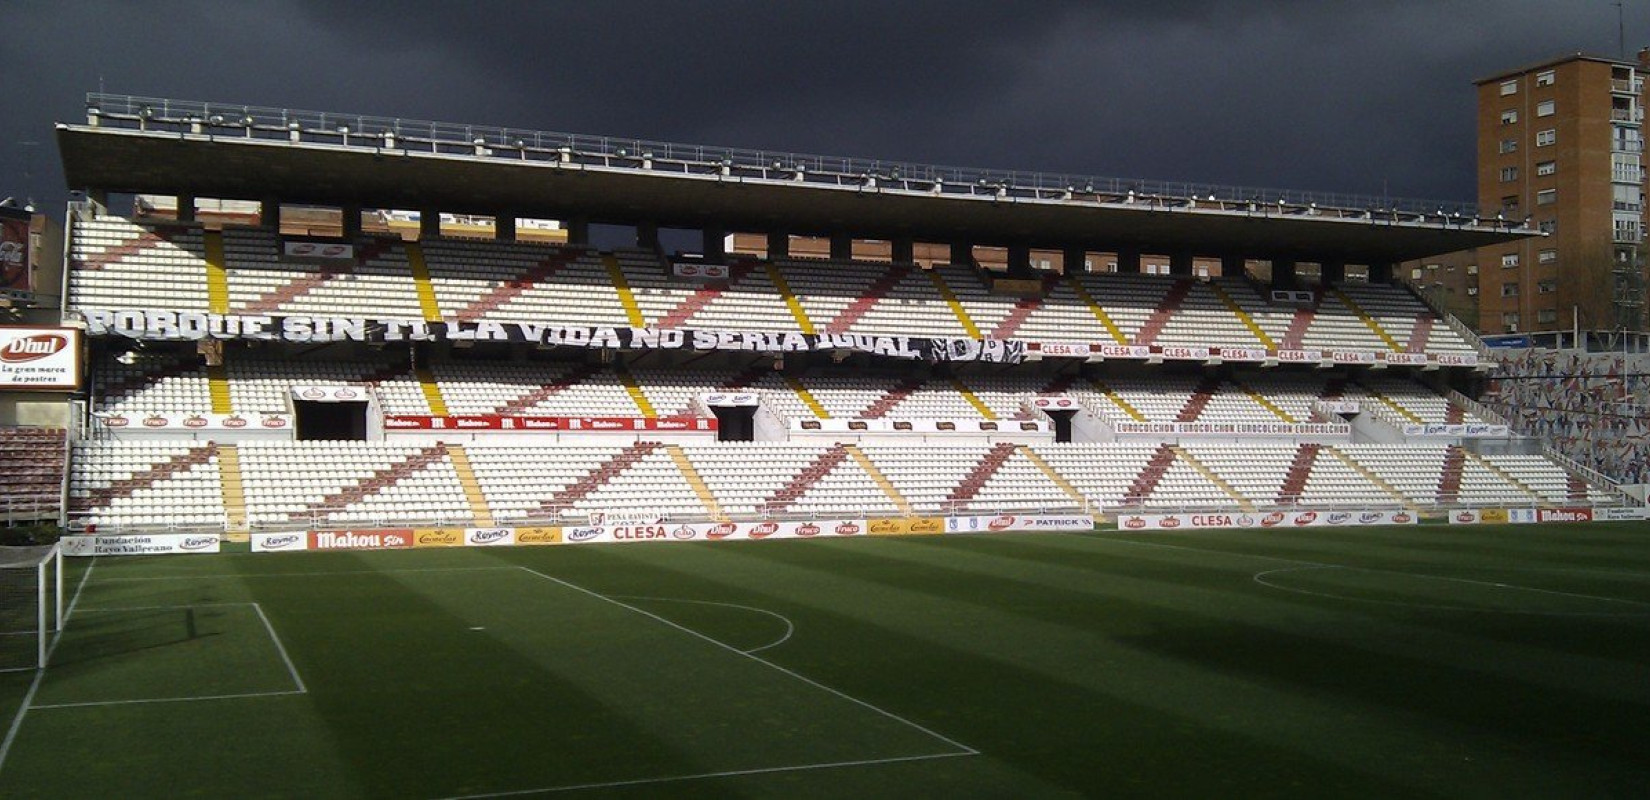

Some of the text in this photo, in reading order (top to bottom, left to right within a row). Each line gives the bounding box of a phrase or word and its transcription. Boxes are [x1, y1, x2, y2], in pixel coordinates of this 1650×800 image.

[85, 309, 272, 340] PORQUE
[283, 316, 366, 342] SIN
[445, 320, 508, 340] LA
[518, 323, 620, 348] VIDA
[629, 327, 684, 348] NO
[693, 331, 809, 351] SERIA
[815, 333, 921, 357] IGUAL
[9, 337, 57, 354] Dhul
[1042, 345, 1071, 354] CLESA
[1103, 346, 1131, 356] CLESA
[1164, 348, 1192, 358] CLESA
[1222, 349, 1248, 359] CLESA
[1278, 350, 1305, 360] CLESA
[1333, 352, 1360, 361] CLESA
[1117, 423, 1175, 433] EUROCOLCHON
[1179, 423, 1235, 433] EUROCOLCHON
[1237, 424, 1293, 434] EUROCOLCHON
[1295, 425, 1349, 434] EUROCOLCHON
[1191, 515, 1232, 526] CLESA
[613, 526, 667, 539] CLESA
[317, 531, 381, 549] Mahou
